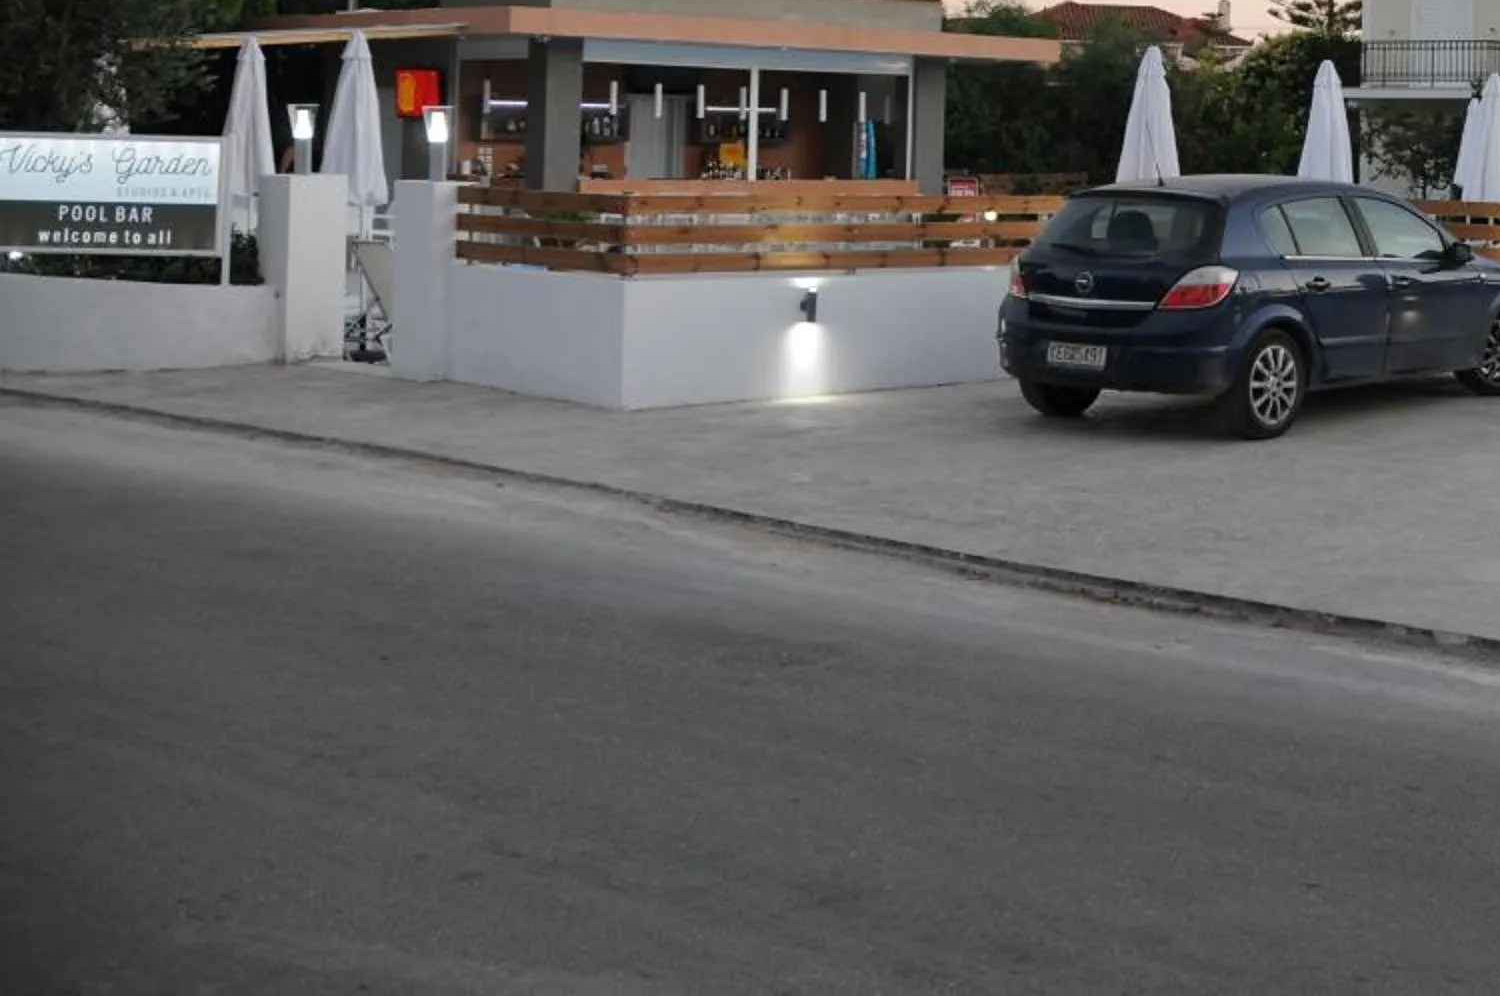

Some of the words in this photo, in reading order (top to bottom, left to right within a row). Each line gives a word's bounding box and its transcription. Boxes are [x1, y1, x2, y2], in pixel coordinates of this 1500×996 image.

[112, 147, 212, 184] Garden
[58, 204, 109, 223] POOL
[115, 205, 153, 224] BAR
[38, 227, 118, 244] welcome
[124, 229, 141, 244] to
[148, 228, 171, 245] all
